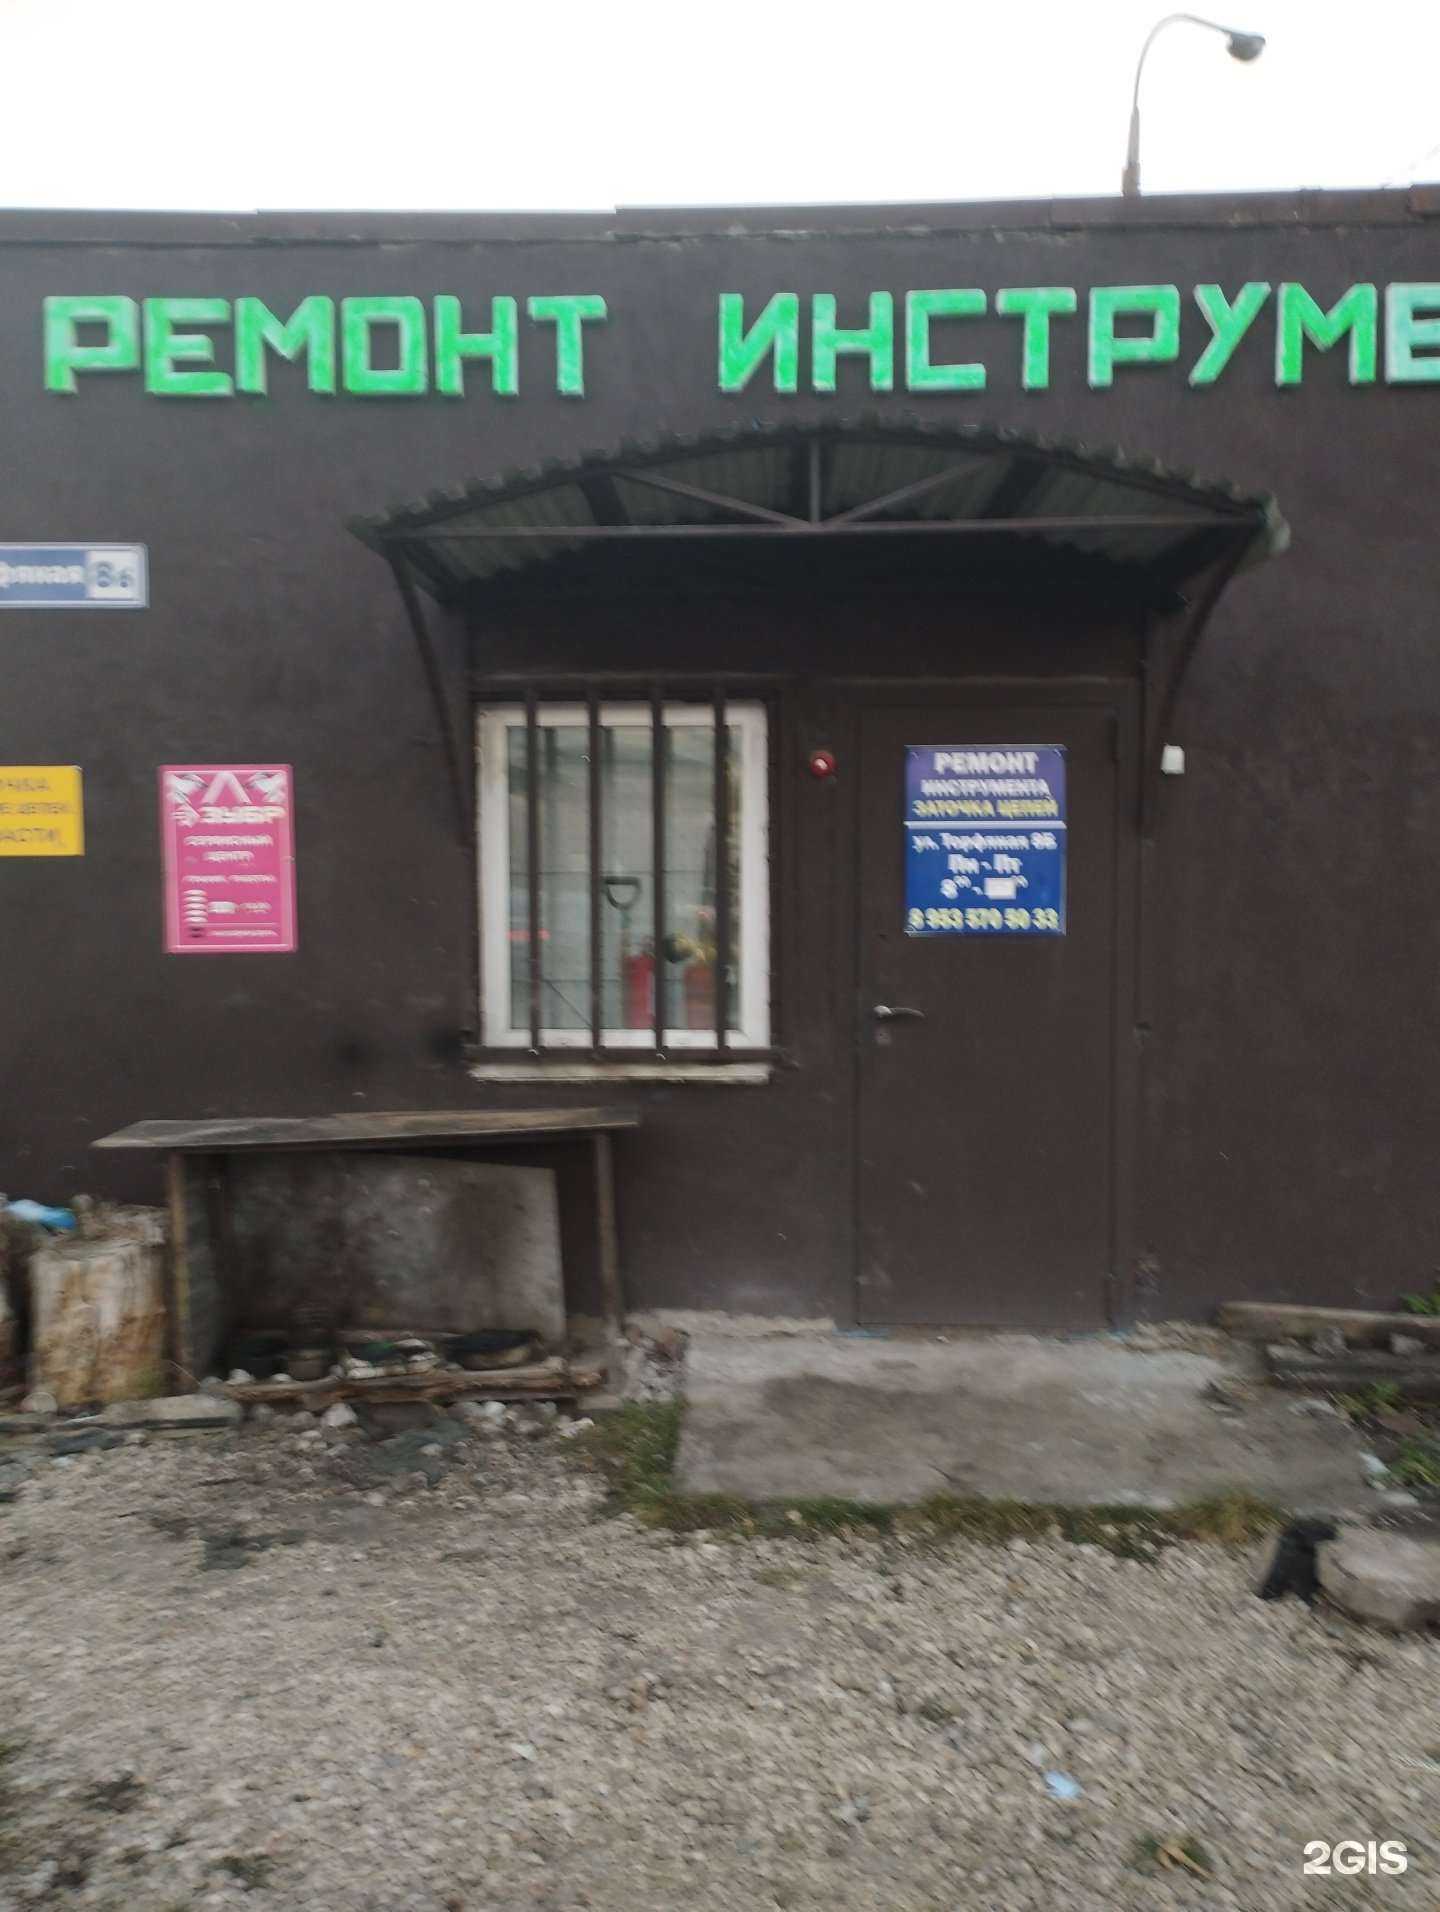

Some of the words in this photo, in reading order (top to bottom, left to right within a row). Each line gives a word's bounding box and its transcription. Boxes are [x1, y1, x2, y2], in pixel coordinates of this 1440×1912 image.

[43, 294, 607, 398] РЕМОНТ
[934, 752, 1039, 774] РЕМОНТ
[921, 779, 1051, 797] ИНСТРУМЕНТА
[912, 800, 995, 817] ЗАТОЧКА
[948, 854, 979, 874] Пн
[993, 854, 1022, 874] Пт
